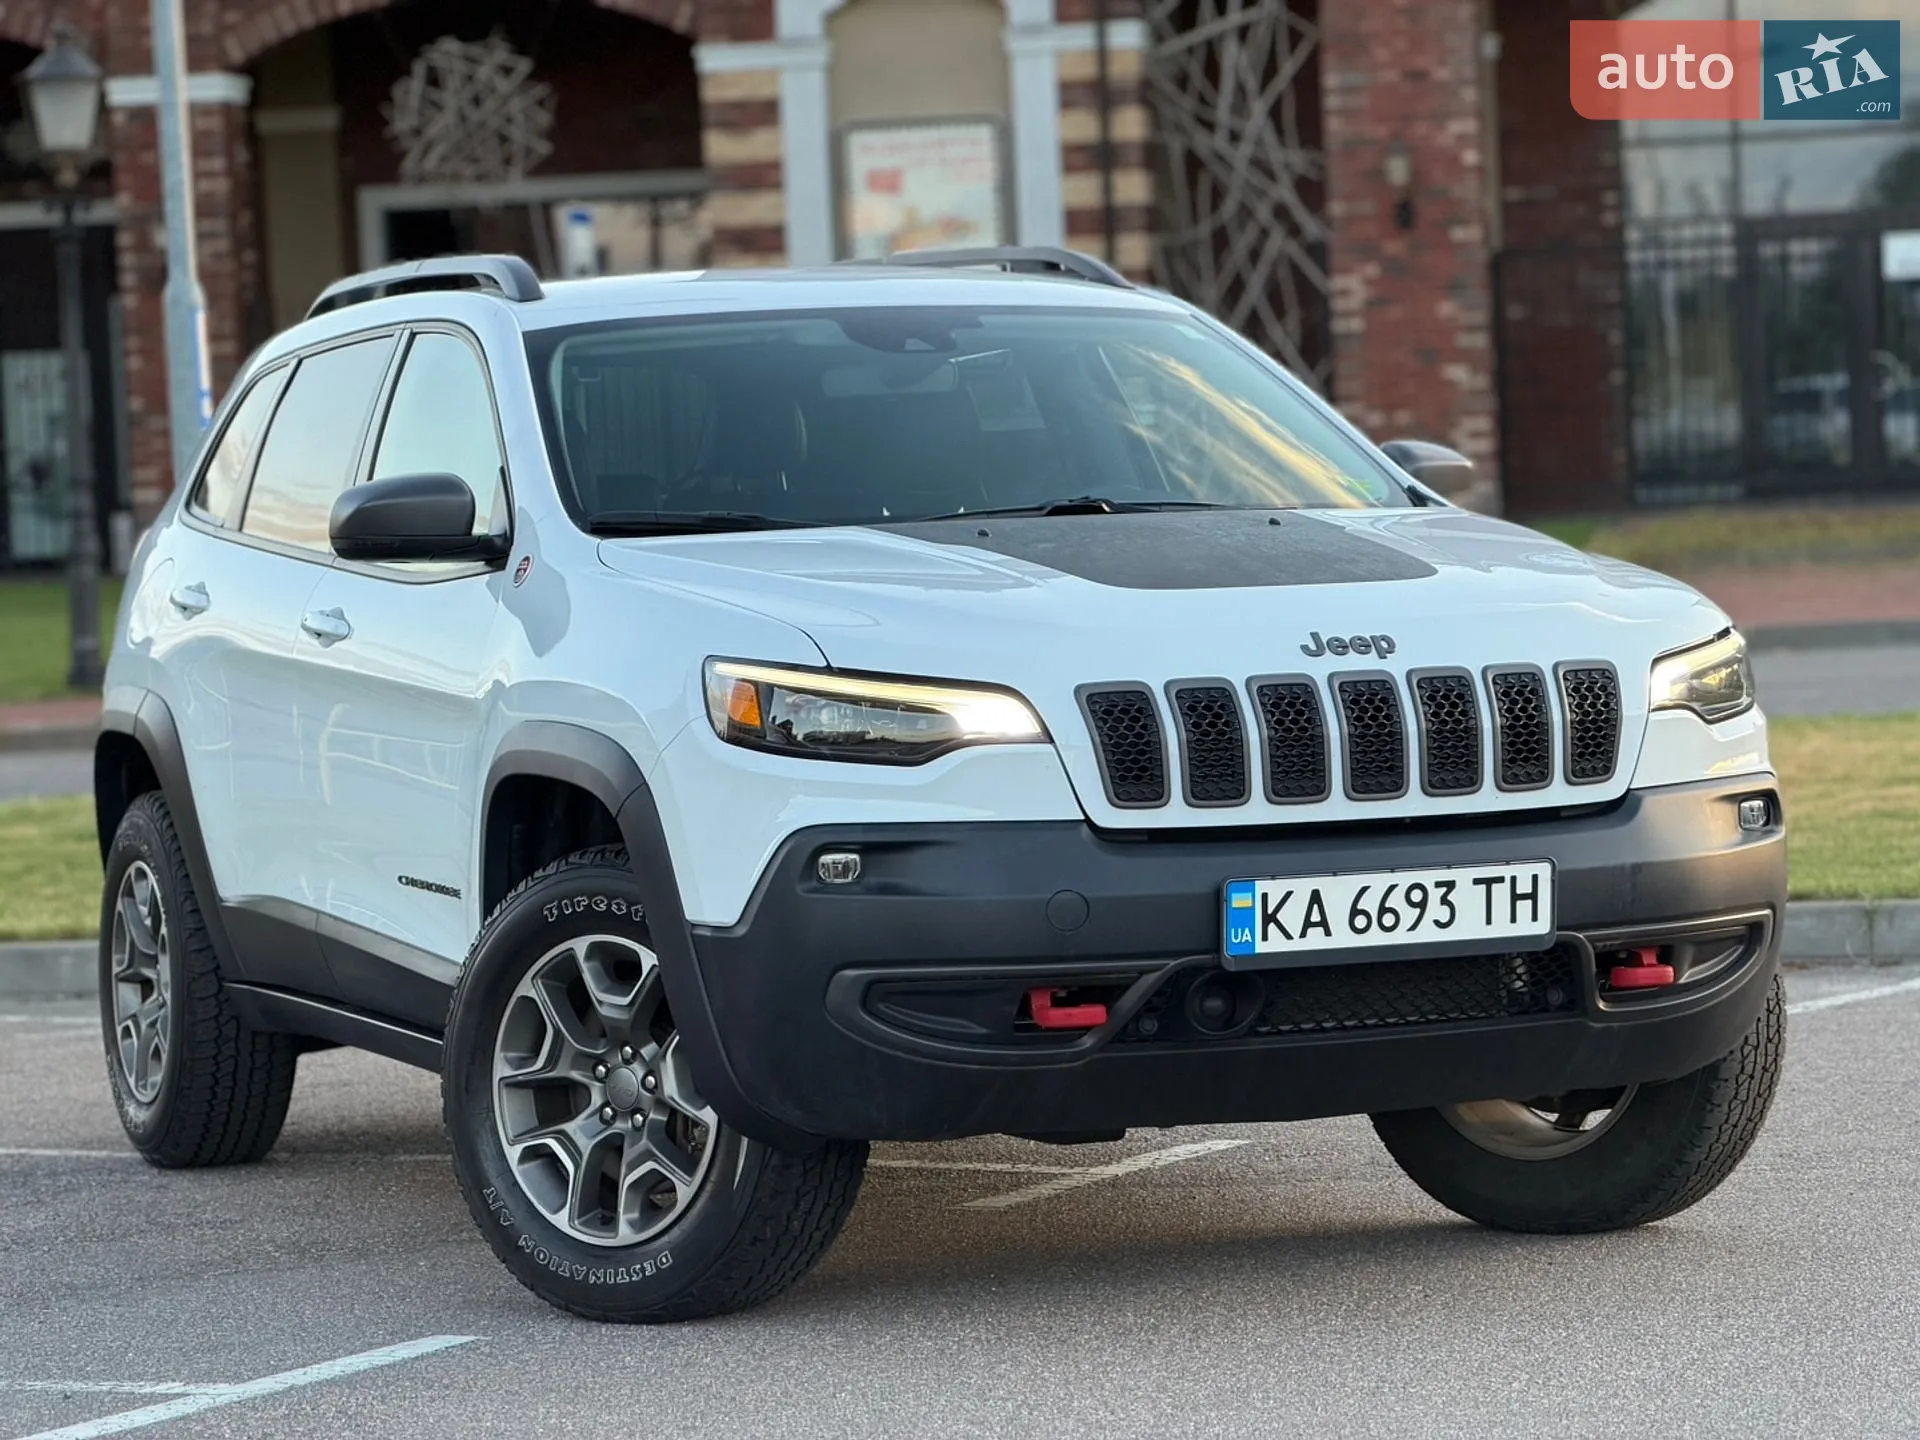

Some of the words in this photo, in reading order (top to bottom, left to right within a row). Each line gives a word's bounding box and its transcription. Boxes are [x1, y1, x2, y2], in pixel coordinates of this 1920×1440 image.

[1300, 631, 1396, 659] Jeep
[1261, 888, 1333, 942] KA
[1348, 880, 1457, 935] 6693
[1472, 873, 1540, 926] TH
[1231, 927, 1253, 944] UA
[482, 1186, 515, 1227] A/T
[517, 1234, 674, 1285] DESTINATION
